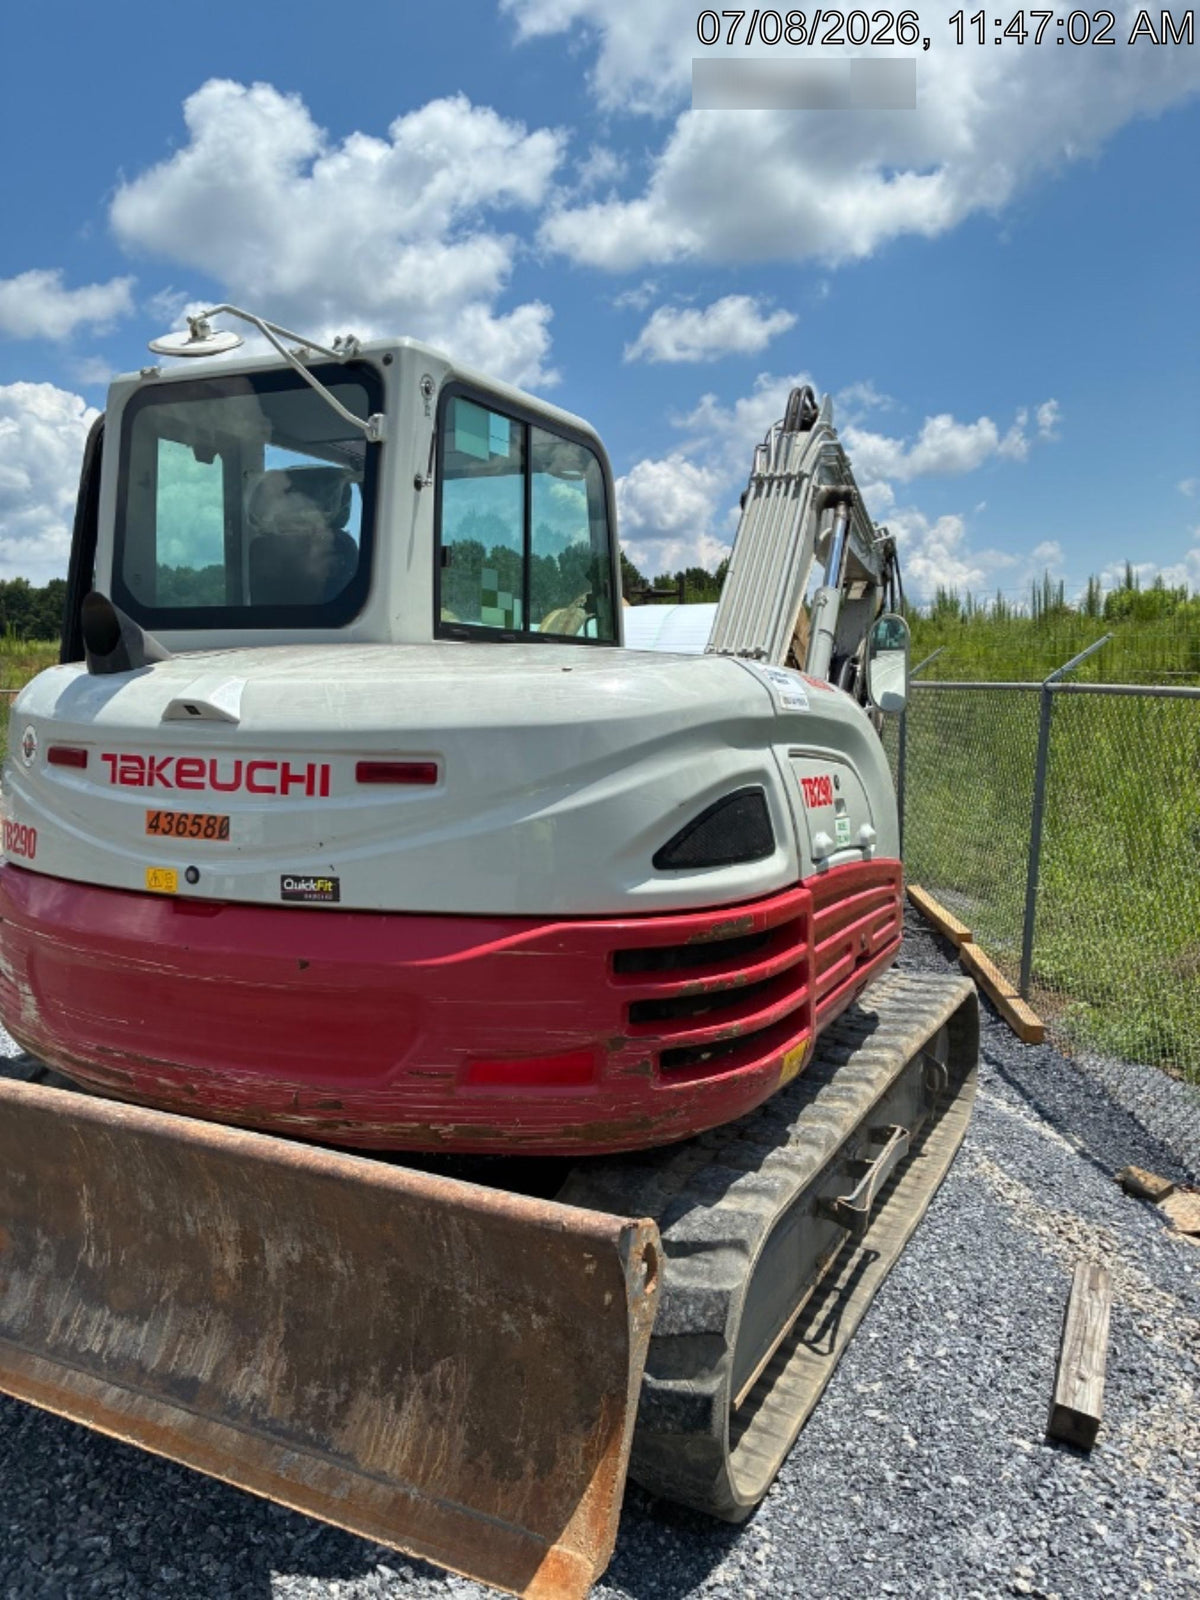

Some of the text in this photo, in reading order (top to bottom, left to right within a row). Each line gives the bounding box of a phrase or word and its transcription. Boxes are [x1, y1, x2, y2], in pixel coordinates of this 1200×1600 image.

[801, 775, 833, 808] TB290
[147, 812, 230, 841] 436580
[283, 878, 333, 891] QuickFit
